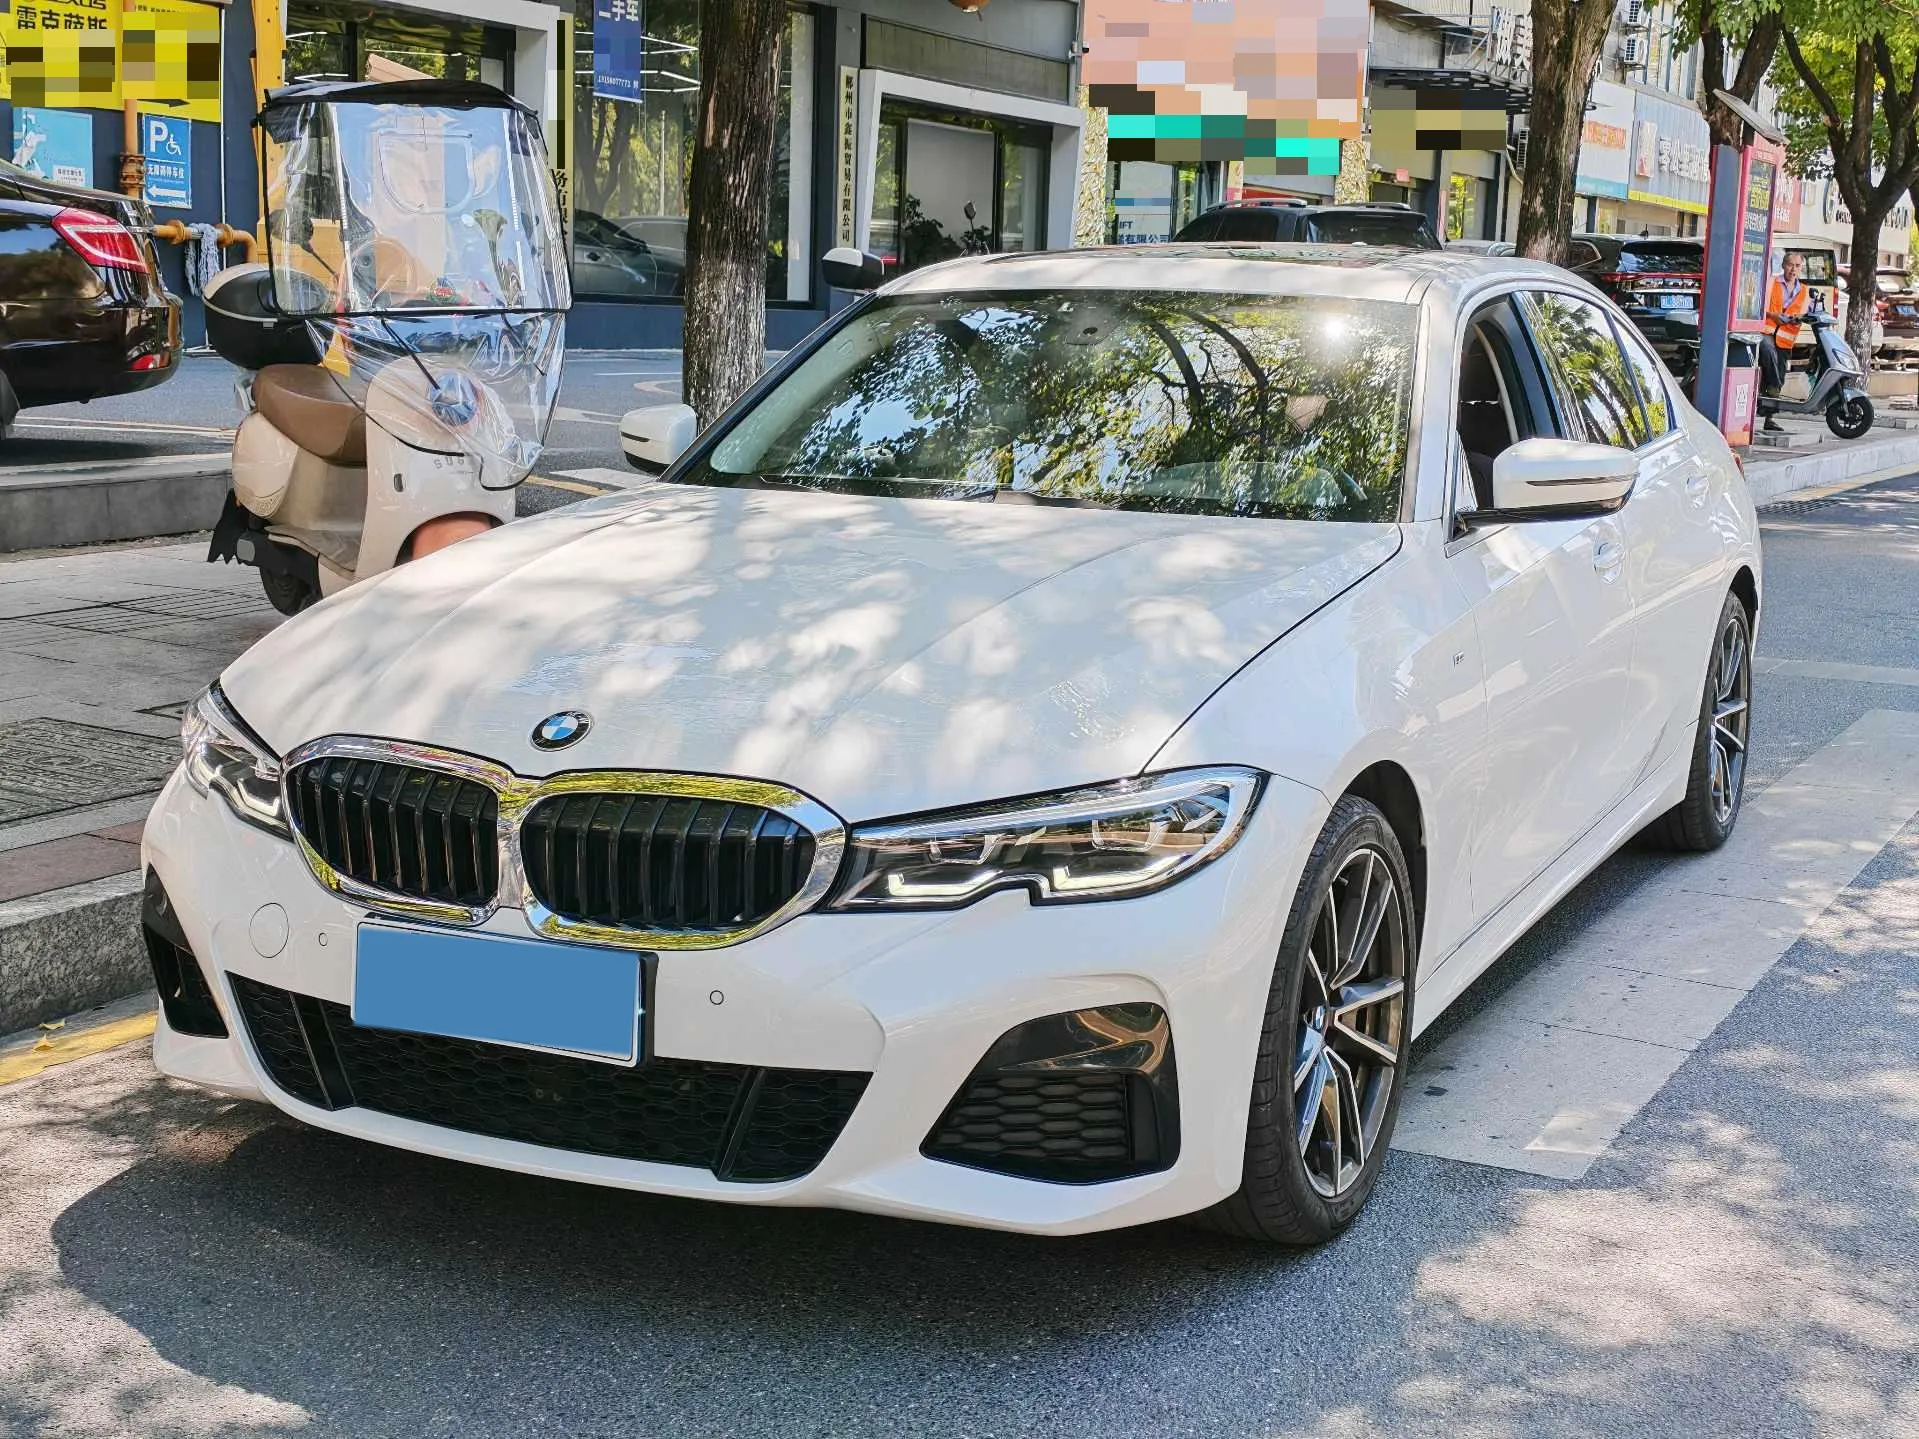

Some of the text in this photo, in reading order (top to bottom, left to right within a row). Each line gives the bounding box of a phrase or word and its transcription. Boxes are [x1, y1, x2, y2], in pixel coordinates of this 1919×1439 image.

[16, 6, 108, 29] 雷克萨斯
[150, 120, 168, 153] P
